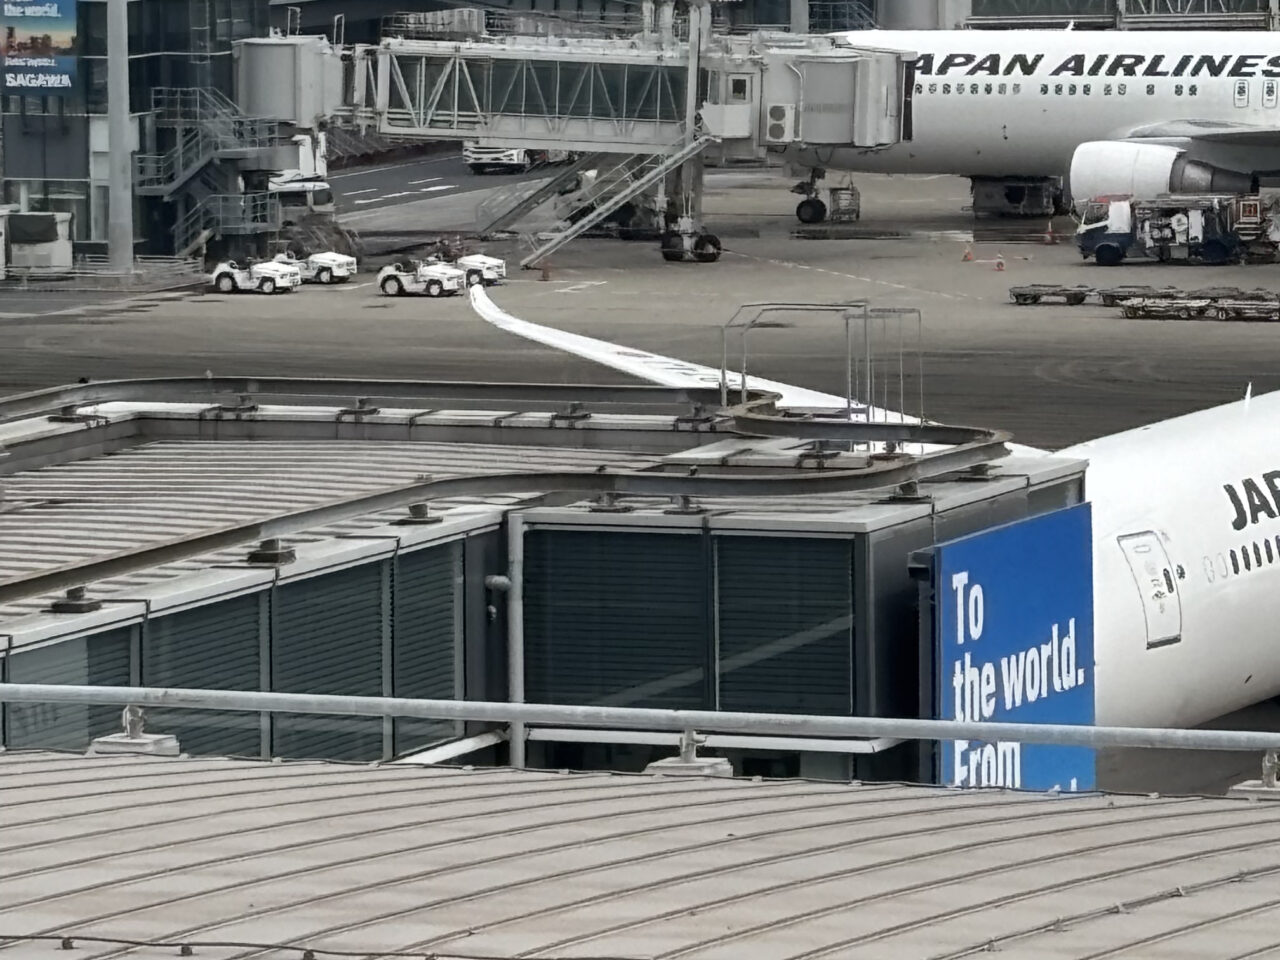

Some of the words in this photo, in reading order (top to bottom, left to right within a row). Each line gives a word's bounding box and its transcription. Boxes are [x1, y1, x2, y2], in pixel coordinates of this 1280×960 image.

[914, 53, 1044, 76] APAN
[952, 571, 984, 645] To
[953, 652, 996, 723] the
[1001, 617, 1085, 710] world.
